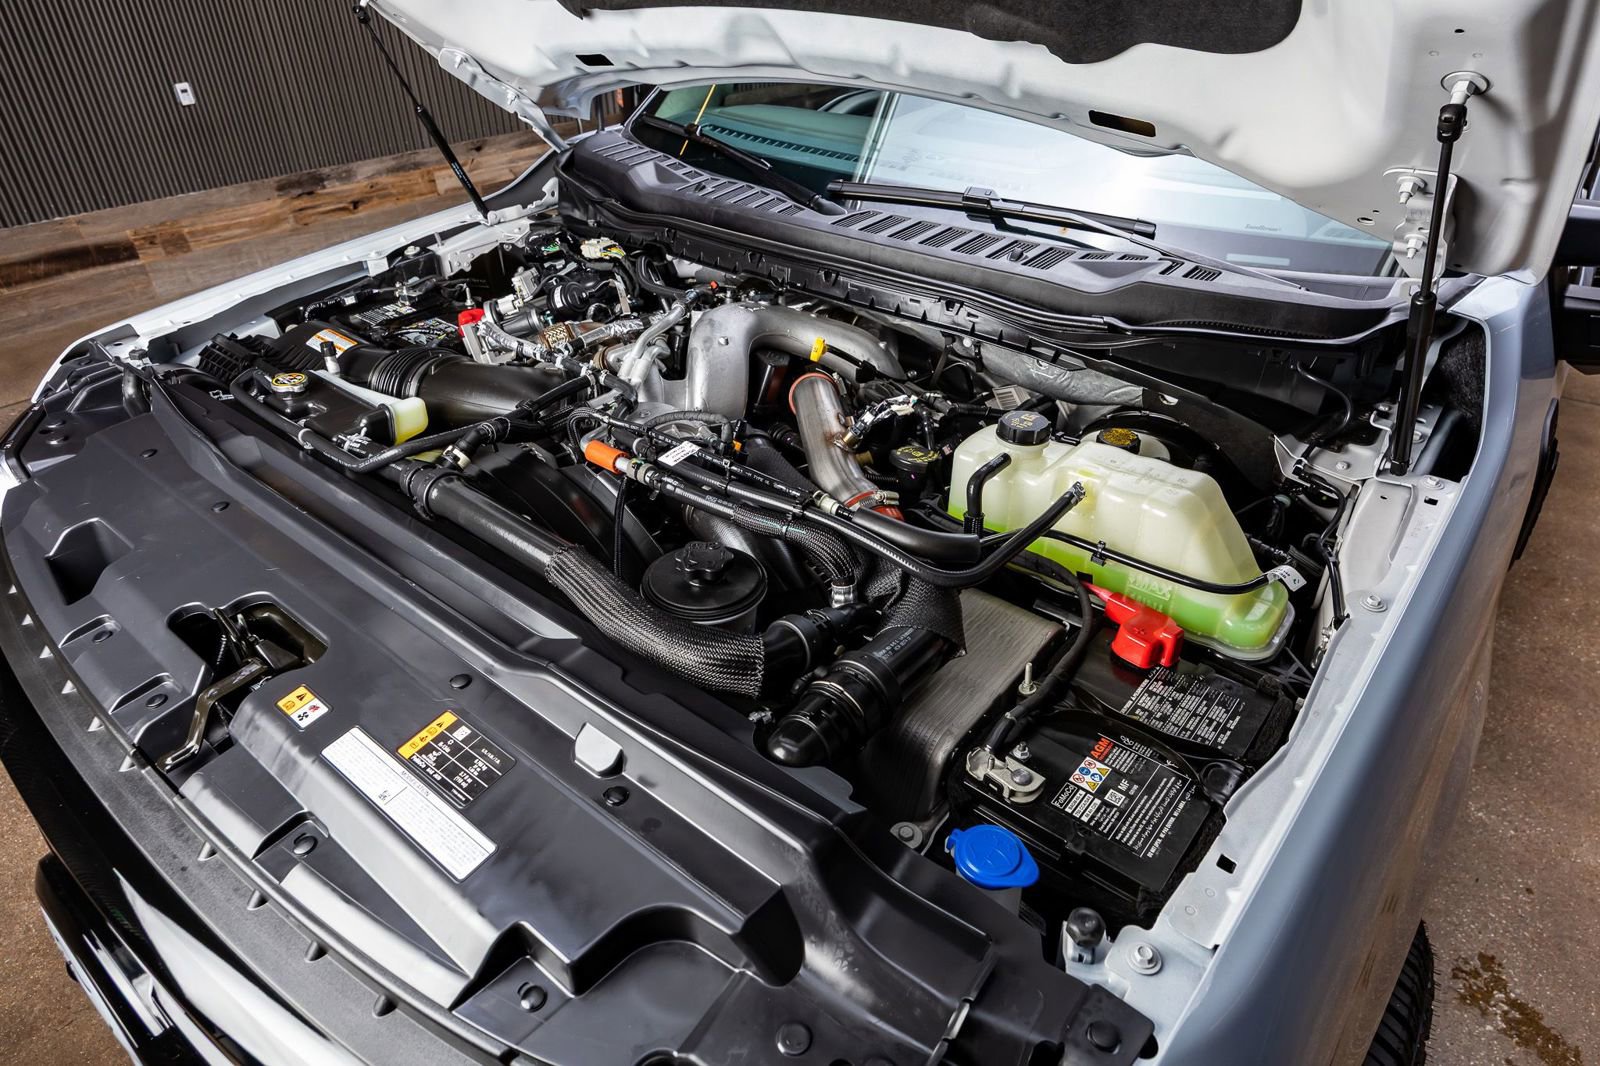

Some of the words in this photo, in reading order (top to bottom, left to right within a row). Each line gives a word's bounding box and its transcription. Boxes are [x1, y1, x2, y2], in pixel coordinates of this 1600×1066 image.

[1089, 737, 1110, 759] AGM
[1054, 784, 1075, 807] FoMoCo
[1118, 779, 1131, 792] MF
